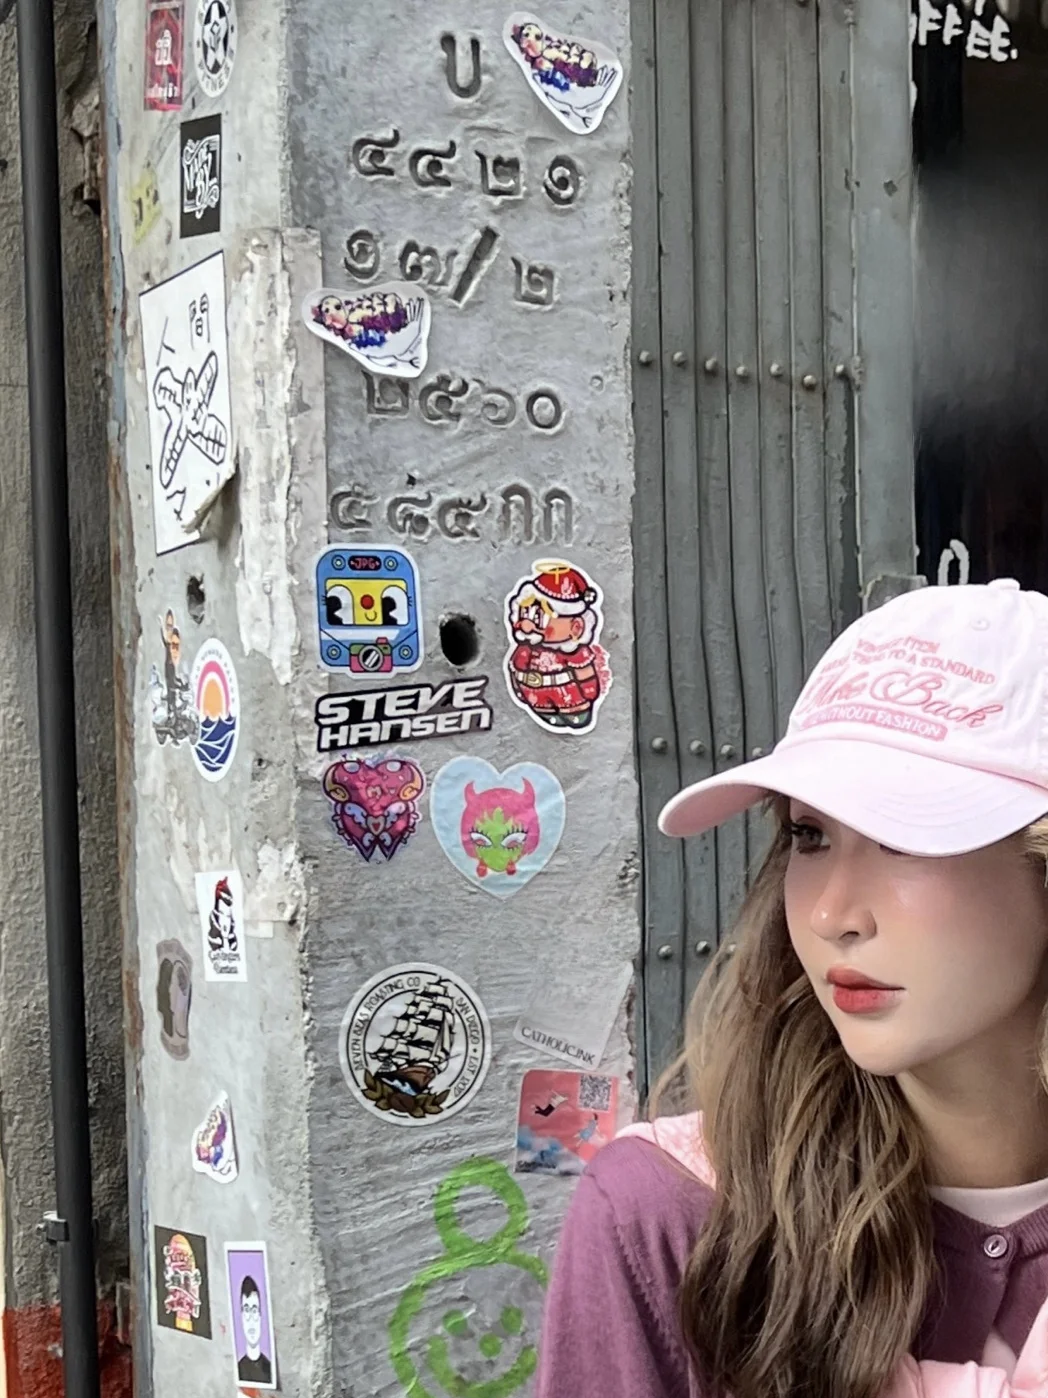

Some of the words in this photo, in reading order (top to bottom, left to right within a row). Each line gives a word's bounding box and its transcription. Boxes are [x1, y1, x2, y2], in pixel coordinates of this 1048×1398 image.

[920, 656, 996, 685] STANDARD
[318, 679, 488, 725] STEVE
[320, 707, 491, 750] HANSEN
[875, 711, 941, 737] FASHION
